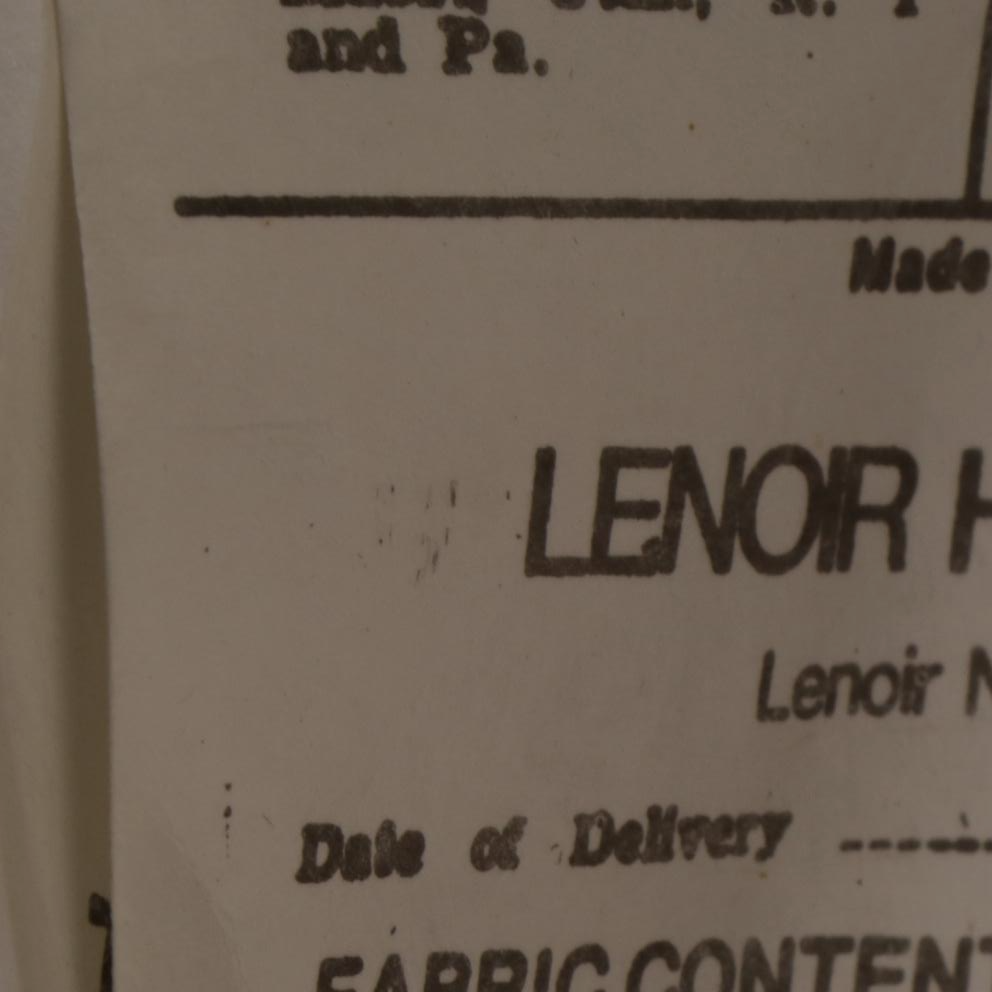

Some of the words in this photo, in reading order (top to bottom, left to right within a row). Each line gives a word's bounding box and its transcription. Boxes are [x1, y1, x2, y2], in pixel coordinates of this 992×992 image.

[286, 15, 406, 75] and
[438, 13, 548, 77] Pa.
[849, 236, 991, 294] Made
[524, 444, 919, 578] LENOIR
[757, 645, 943, 722] Lenoir
[470, 816, 527, 872] of
[569, 805, 792, 867] Delivery
